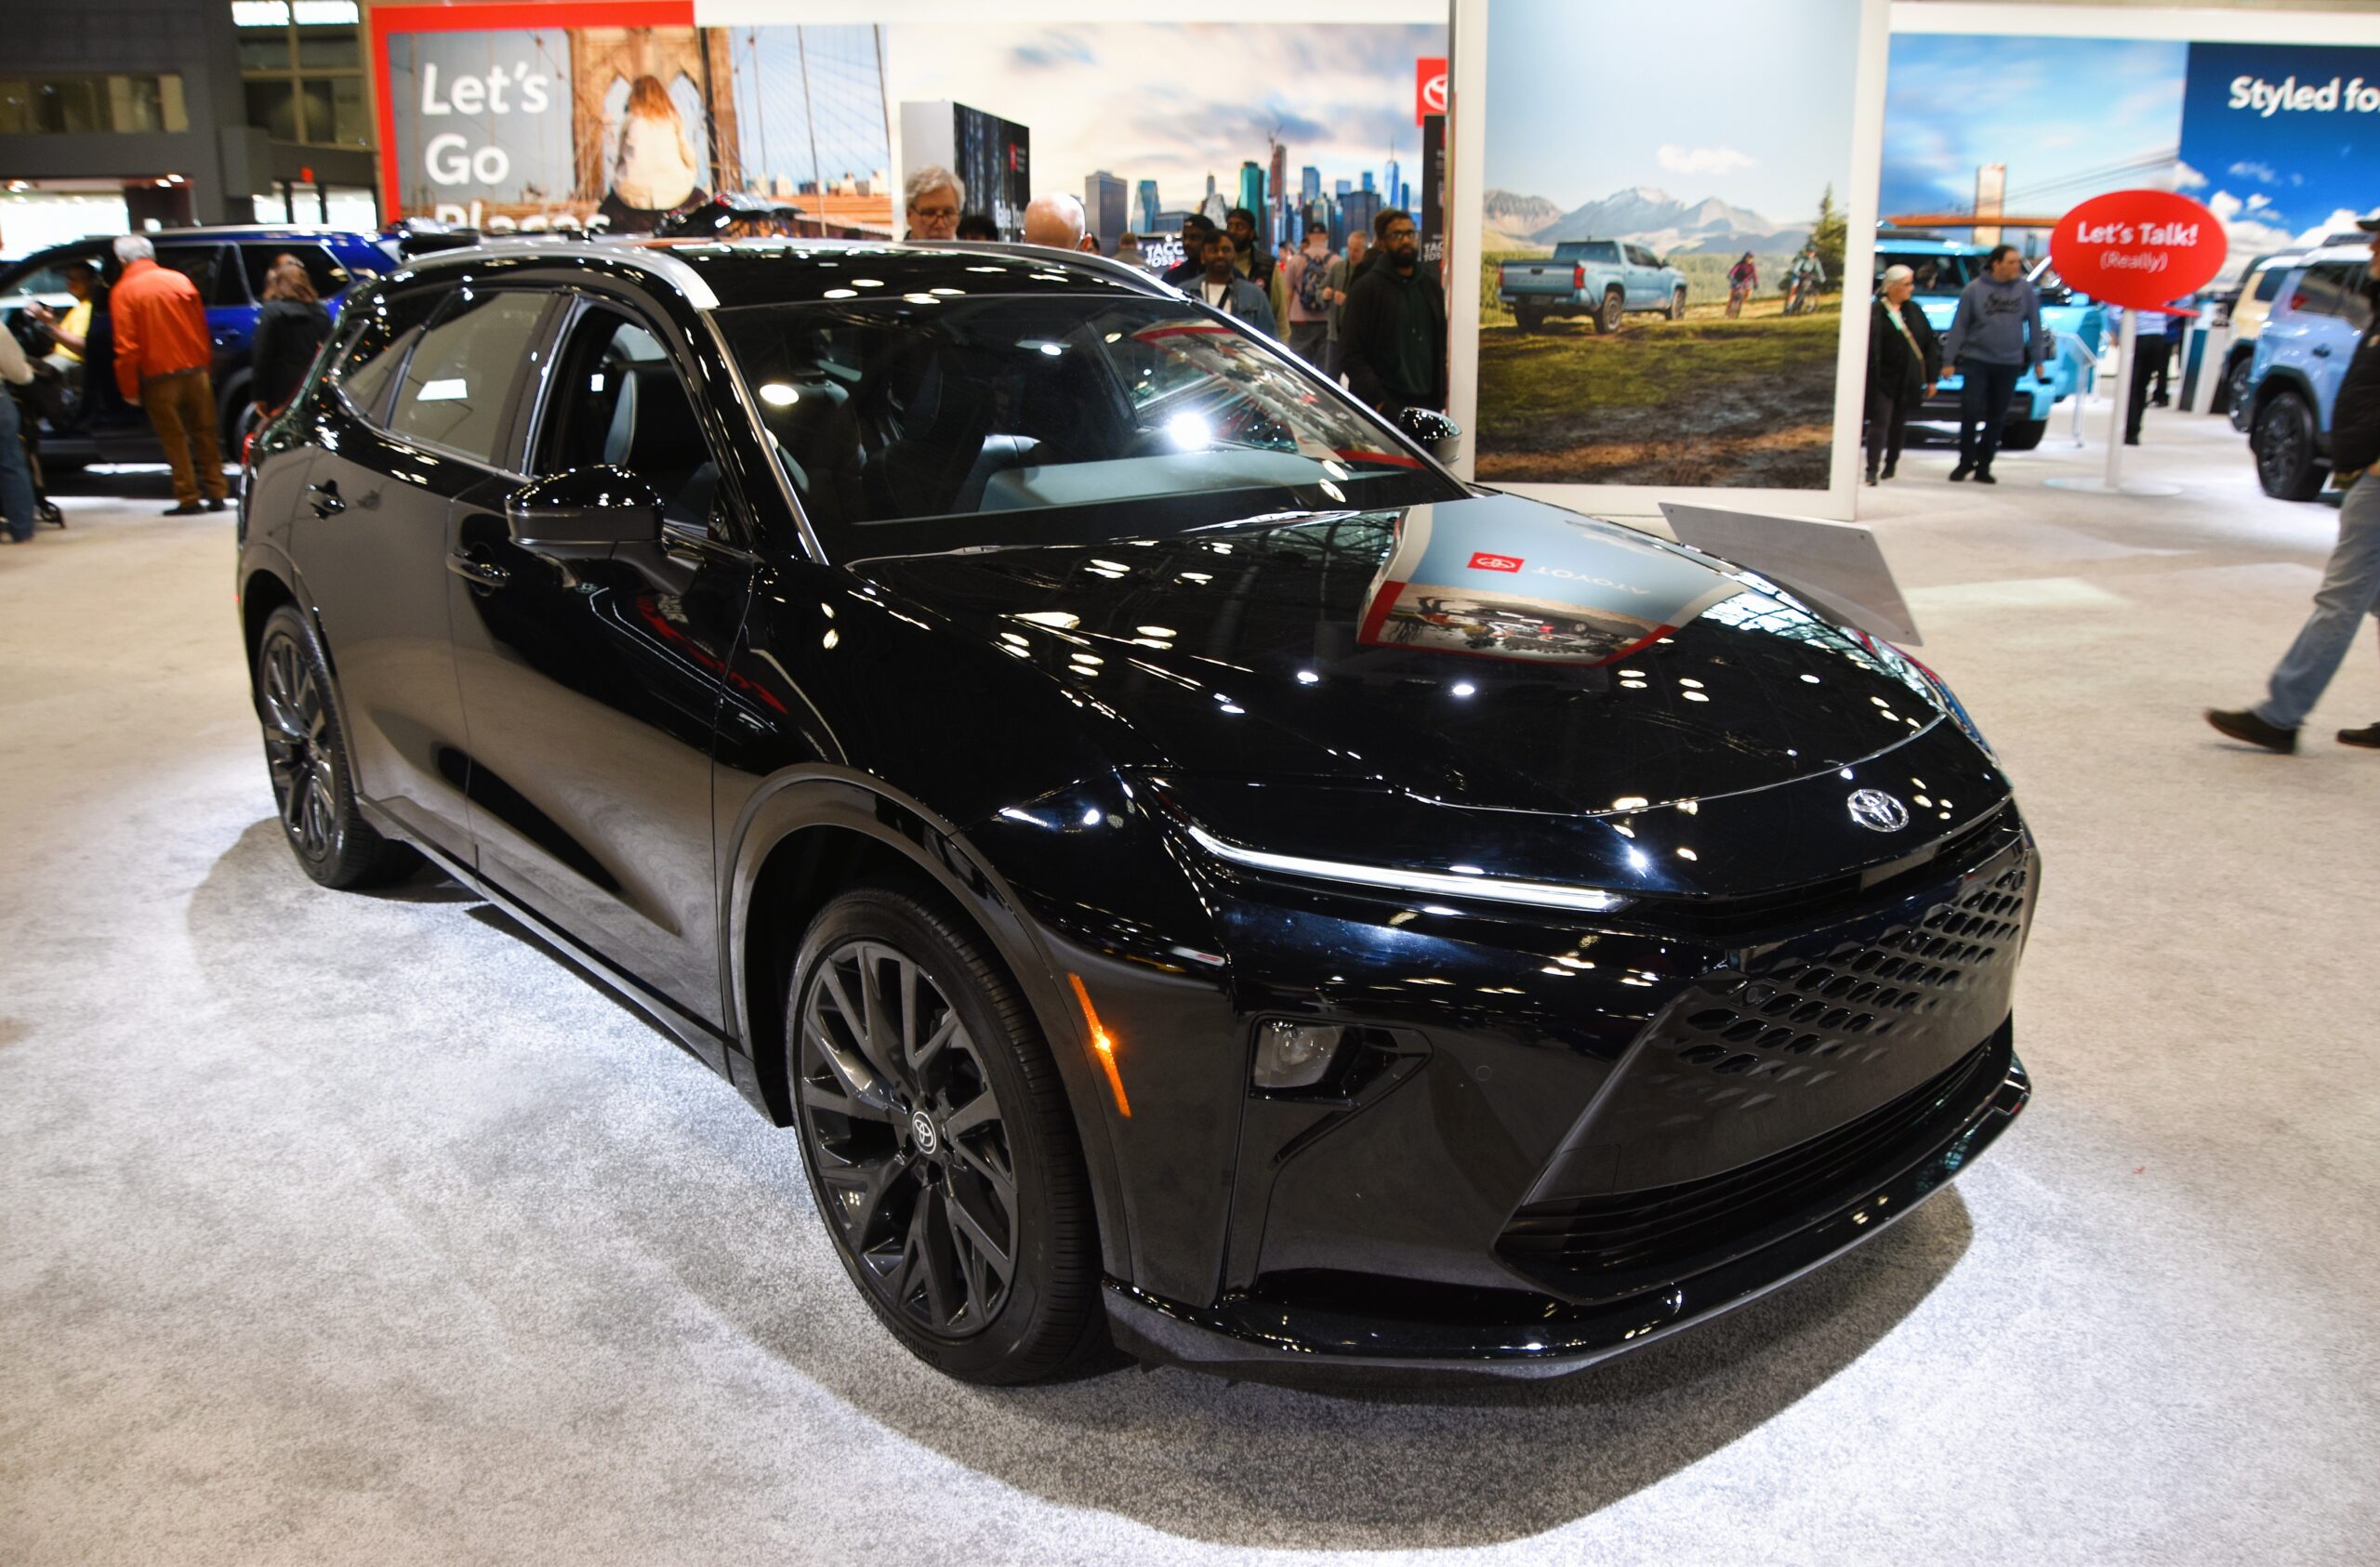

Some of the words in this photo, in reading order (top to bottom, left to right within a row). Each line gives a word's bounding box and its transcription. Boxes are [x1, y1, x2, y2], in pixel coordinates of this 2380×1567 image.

[421, 61, 549, 115] Let's
[2228, 74, 2341, 118] Styled
[2343, 76, 2380, 112] fo
[425, 132, 509, 185] Go
[2076, 220, 2135, 244] Let's
[2137, 222, 2200, 246] Talk!
[2099, 250, 2169, 273] (Really)
